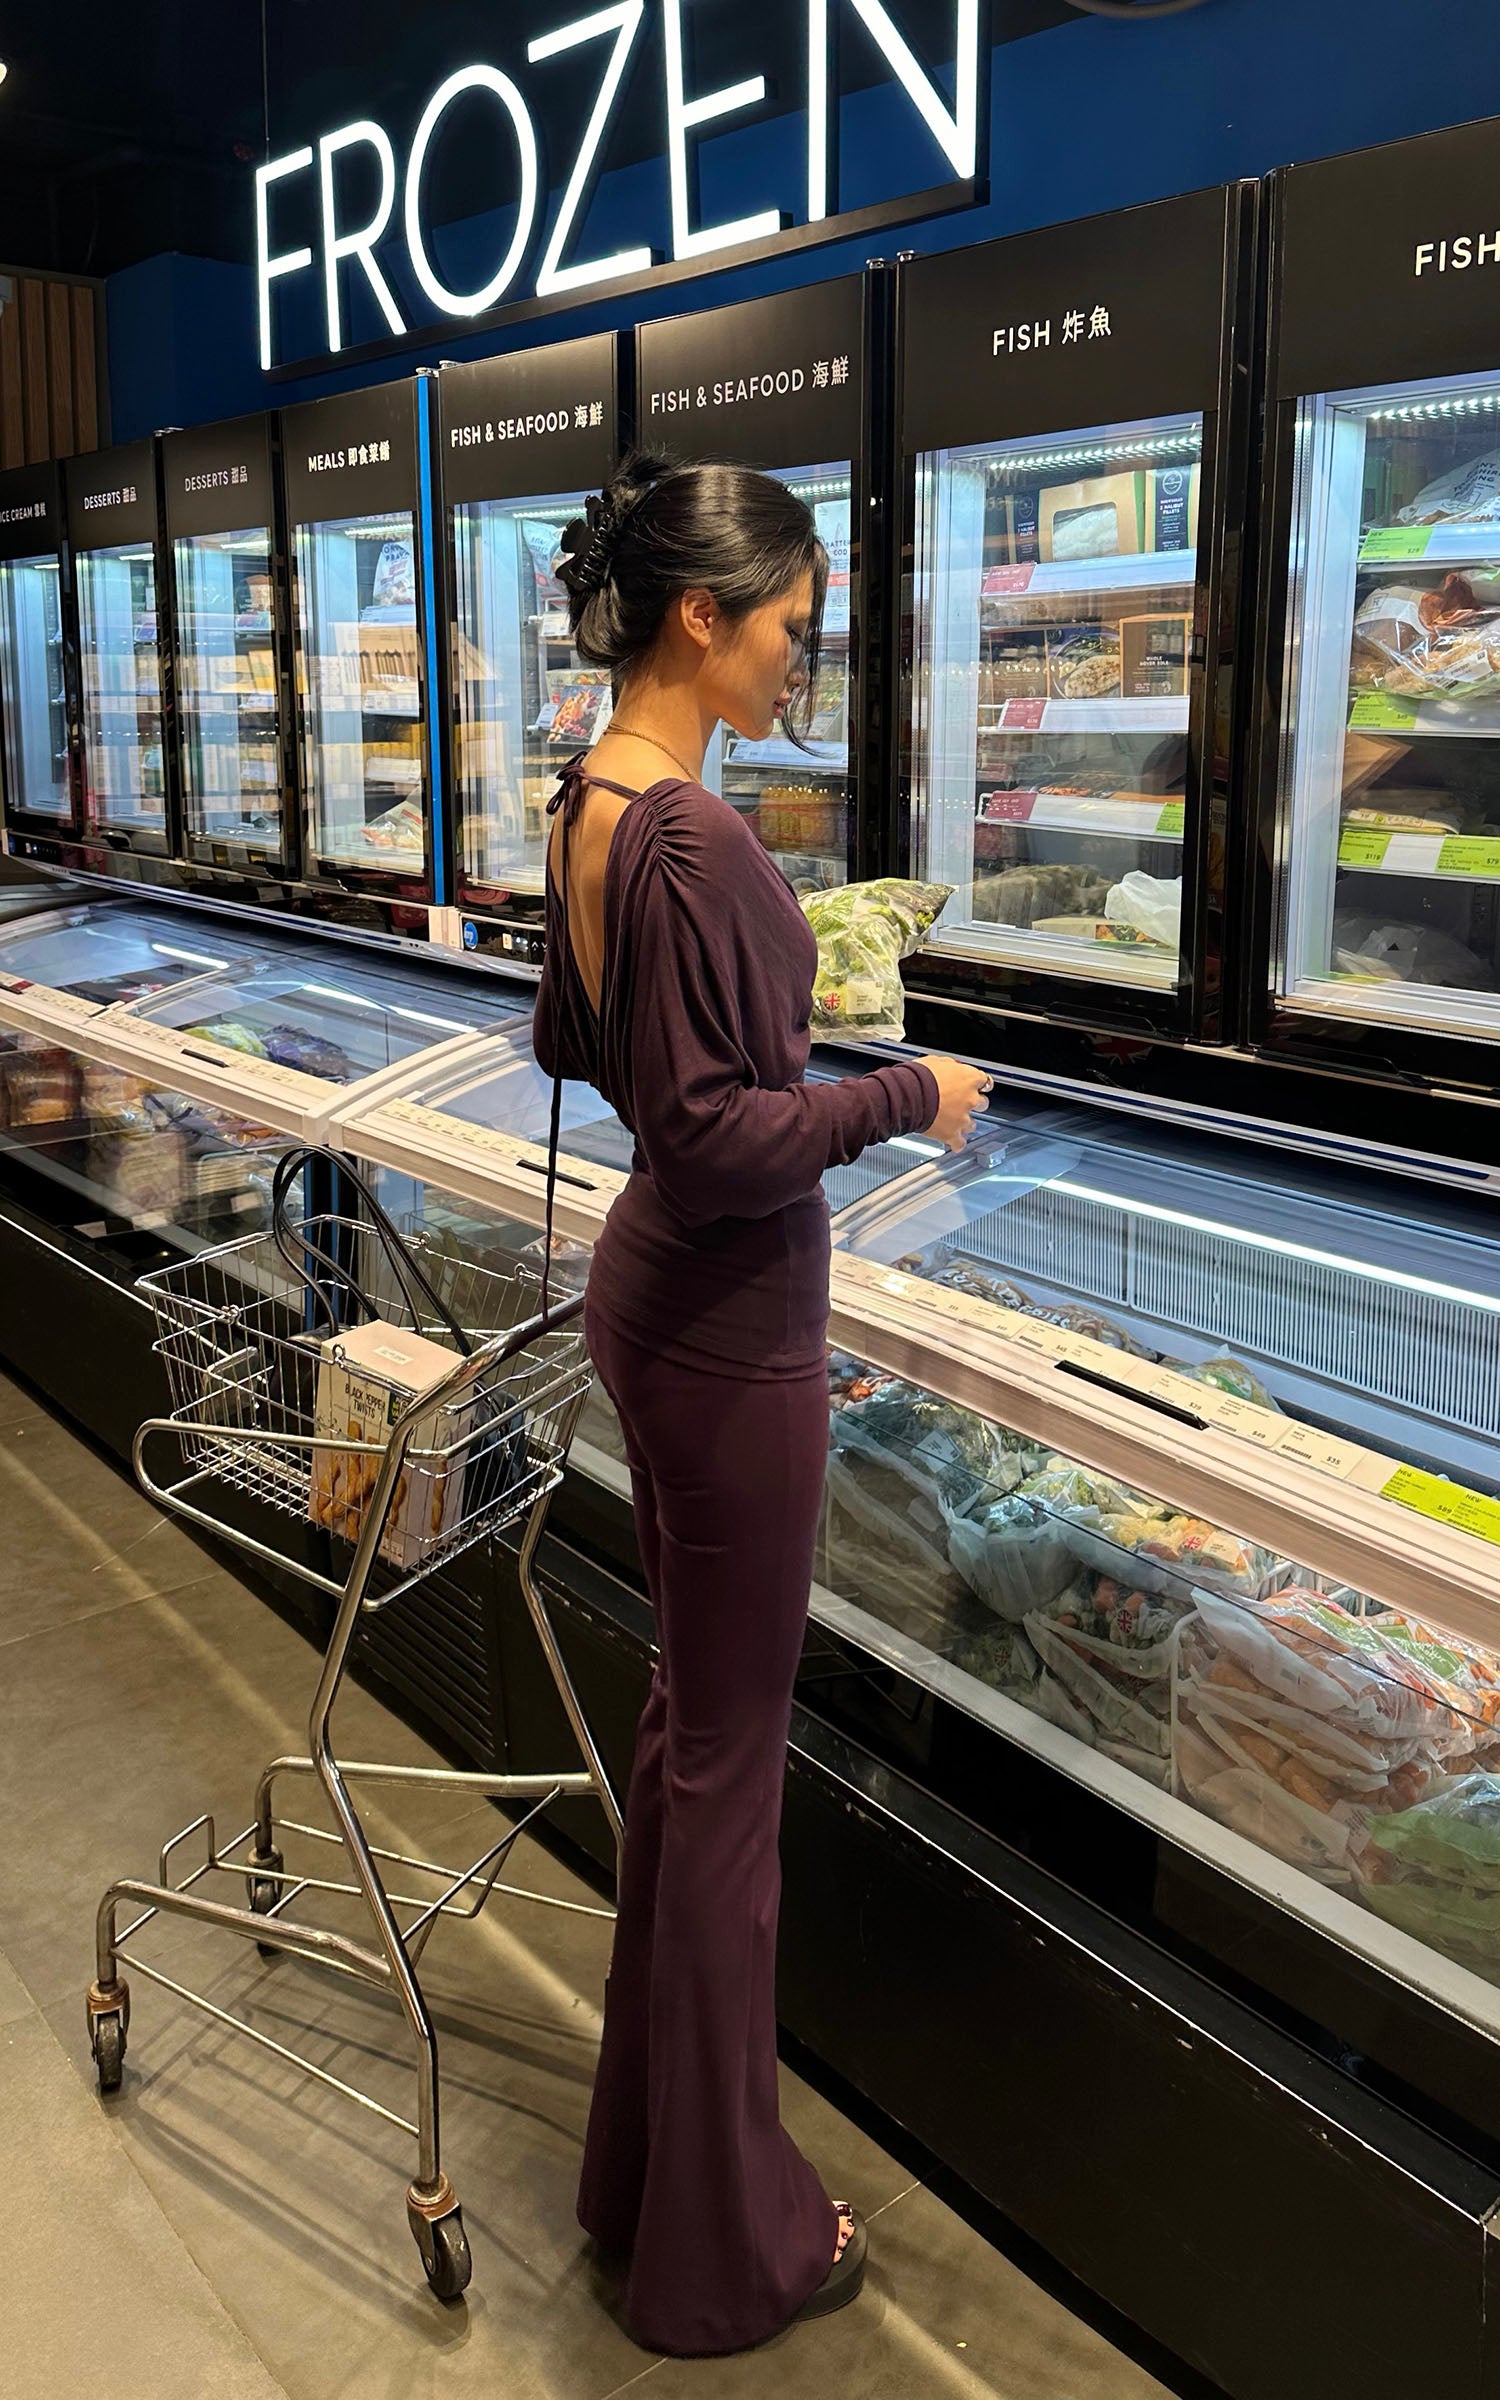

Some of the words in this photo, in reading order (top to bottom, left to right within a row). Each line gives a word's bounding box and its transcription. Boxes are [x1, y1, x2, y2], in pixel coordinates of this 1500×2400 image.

[256, 0, 977, 371] FROZEN
[1415, 230, 1500, 276] FISH
[993, 319, 1051, 356] FISH
[1061, 304, 1112, 345] 炸魚
[651, 388, 690, 415] FISH
[696, 385, 707, 408] &
[712, 368, 804, 405] SEAFOOD
[812, 355, 849, 389] 海鮮
[450, 424, 481, 448] FISH
[484, 422, 495, 443] &
[497, 410, 569, 441] SEAFOOD
[573, 400, 604, 429] 海鮮
[184, 470, 229, 492] DESSERTS
[230, 465, 248, 485] 甜品
[308, 450, 345, 473] MEALS
[10, 506, 33, 521] CREAM
[83, 490, 121, 510] DESSERTS
[353, 1399, 376, 1419] TWISTS
